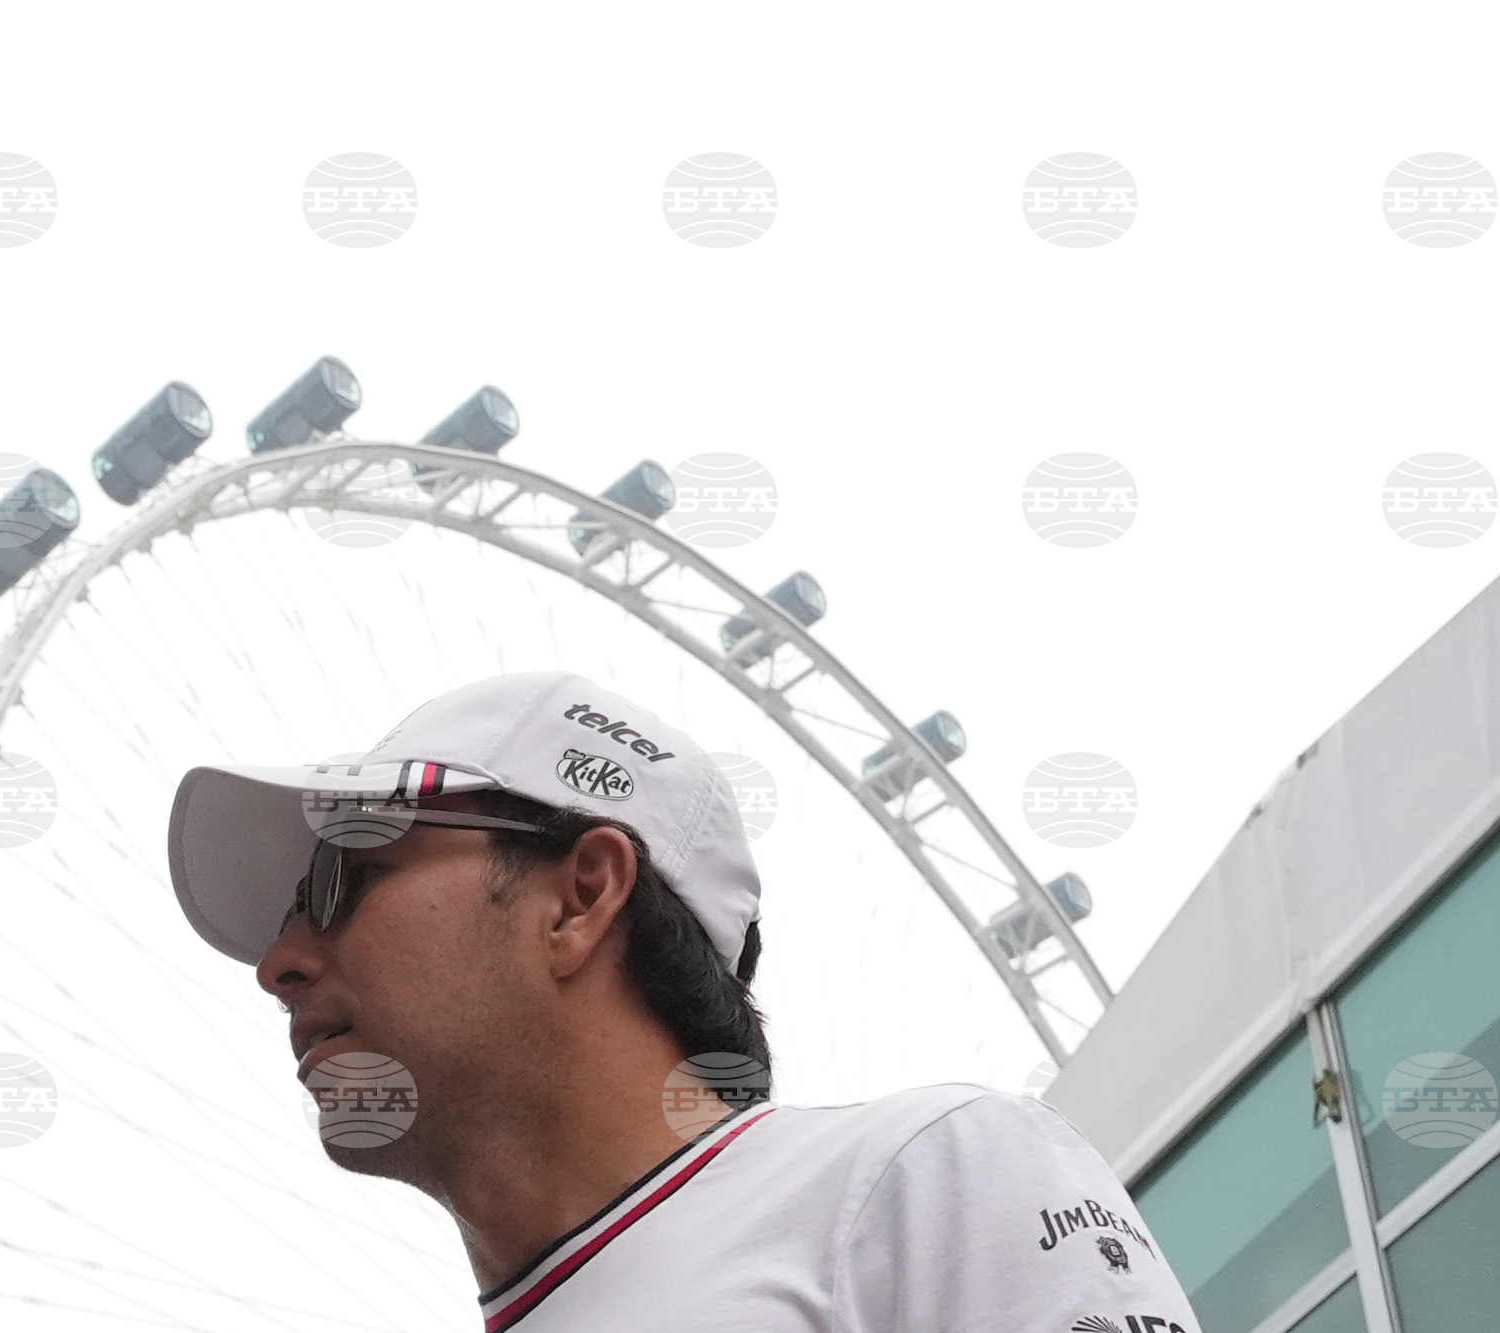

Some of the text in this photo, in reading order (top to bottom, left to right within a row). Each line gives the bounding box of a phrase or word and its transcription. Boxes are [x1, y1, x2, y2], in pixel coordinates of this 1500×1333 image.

[563, 703, 676, 763] telcel
[562, 757, 631, 796] KitKat
[1038, 1207, 1090, 1251] JIM
